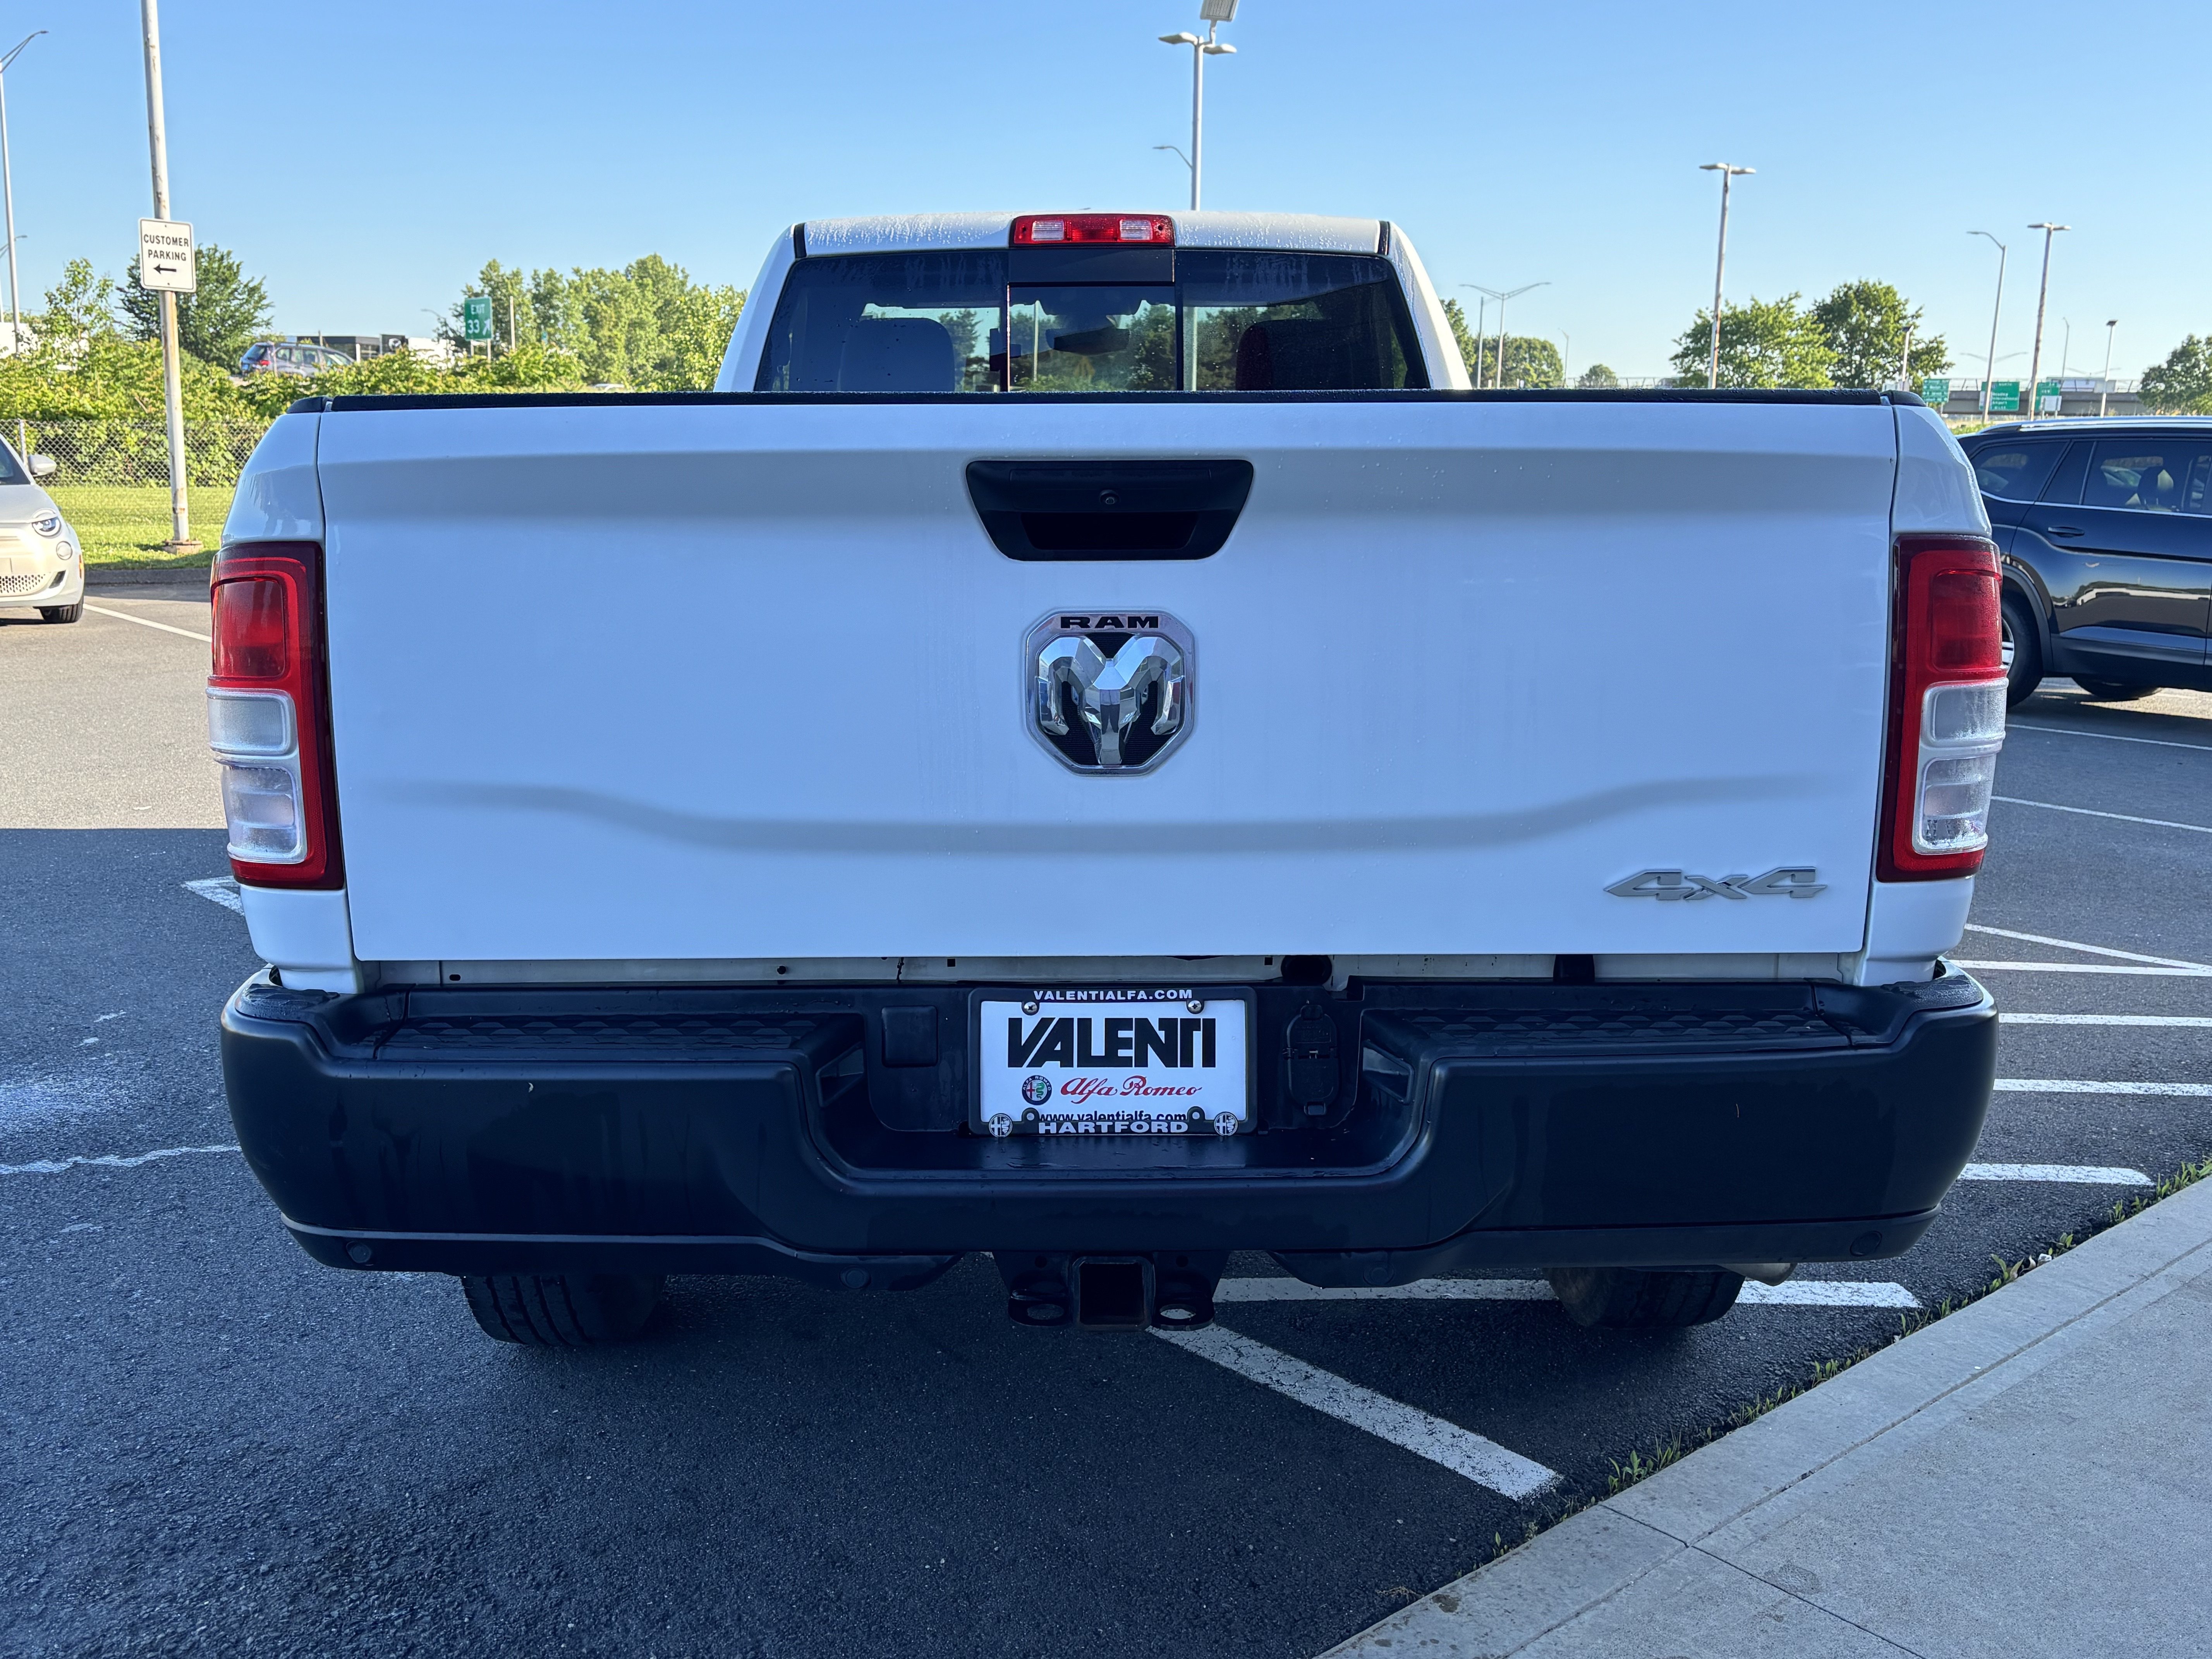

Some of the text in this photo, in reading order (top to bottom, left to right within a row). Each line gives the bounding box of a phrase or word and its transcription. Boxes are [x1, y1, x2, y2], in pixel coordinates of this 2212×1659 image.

[144, 234, 189, 247] CUSTOMER
[148, 249, 186, 261] PARKING
[471, 304, 485, 315] EXIT
[467, 319, 479, 334] 33
[1061, 616, 1159, 629] RAM
[1034, 989, 1192, 1001] VALENTIALFA.COM
[1008, 1018, 1216, 1068] VALENTI
[1035, 1076, 1051, 1091] ROMEO
[1060, 1075, 1202, 1104] Alfa Romeo
[1039, 1110, 1187, 1120] wwwvalentialfacom
[1039, 1121, 1188, 1133] HARTFORD
